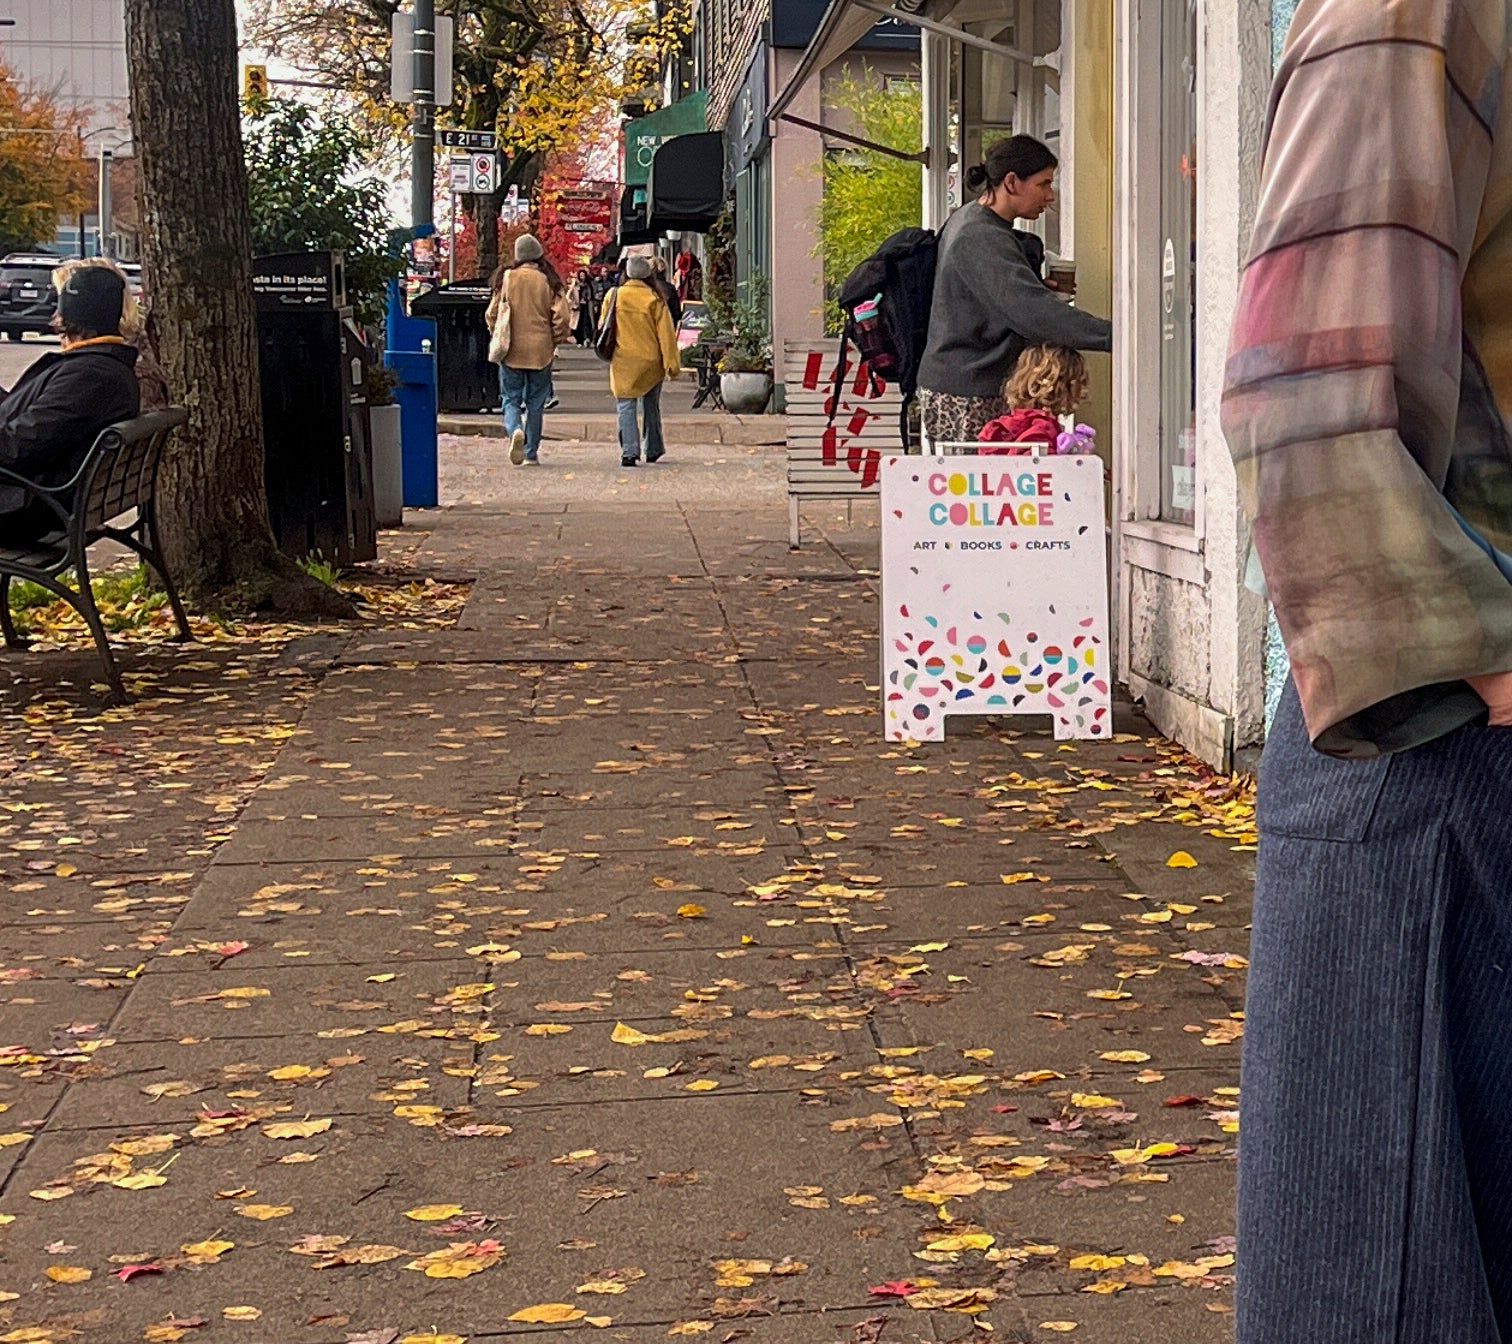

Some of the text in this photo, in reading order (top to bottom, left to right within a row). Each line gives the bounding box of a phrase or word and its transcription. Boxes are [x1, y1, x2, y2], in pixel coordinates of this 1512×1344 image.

[446, 132, 454, 145] E
[928, 472, 1053, 496] COLLAGE
[928, 503, 1054, 526] COLLAGE
[913, 541, 1071, 550] ART BOOKS CRAFTS
